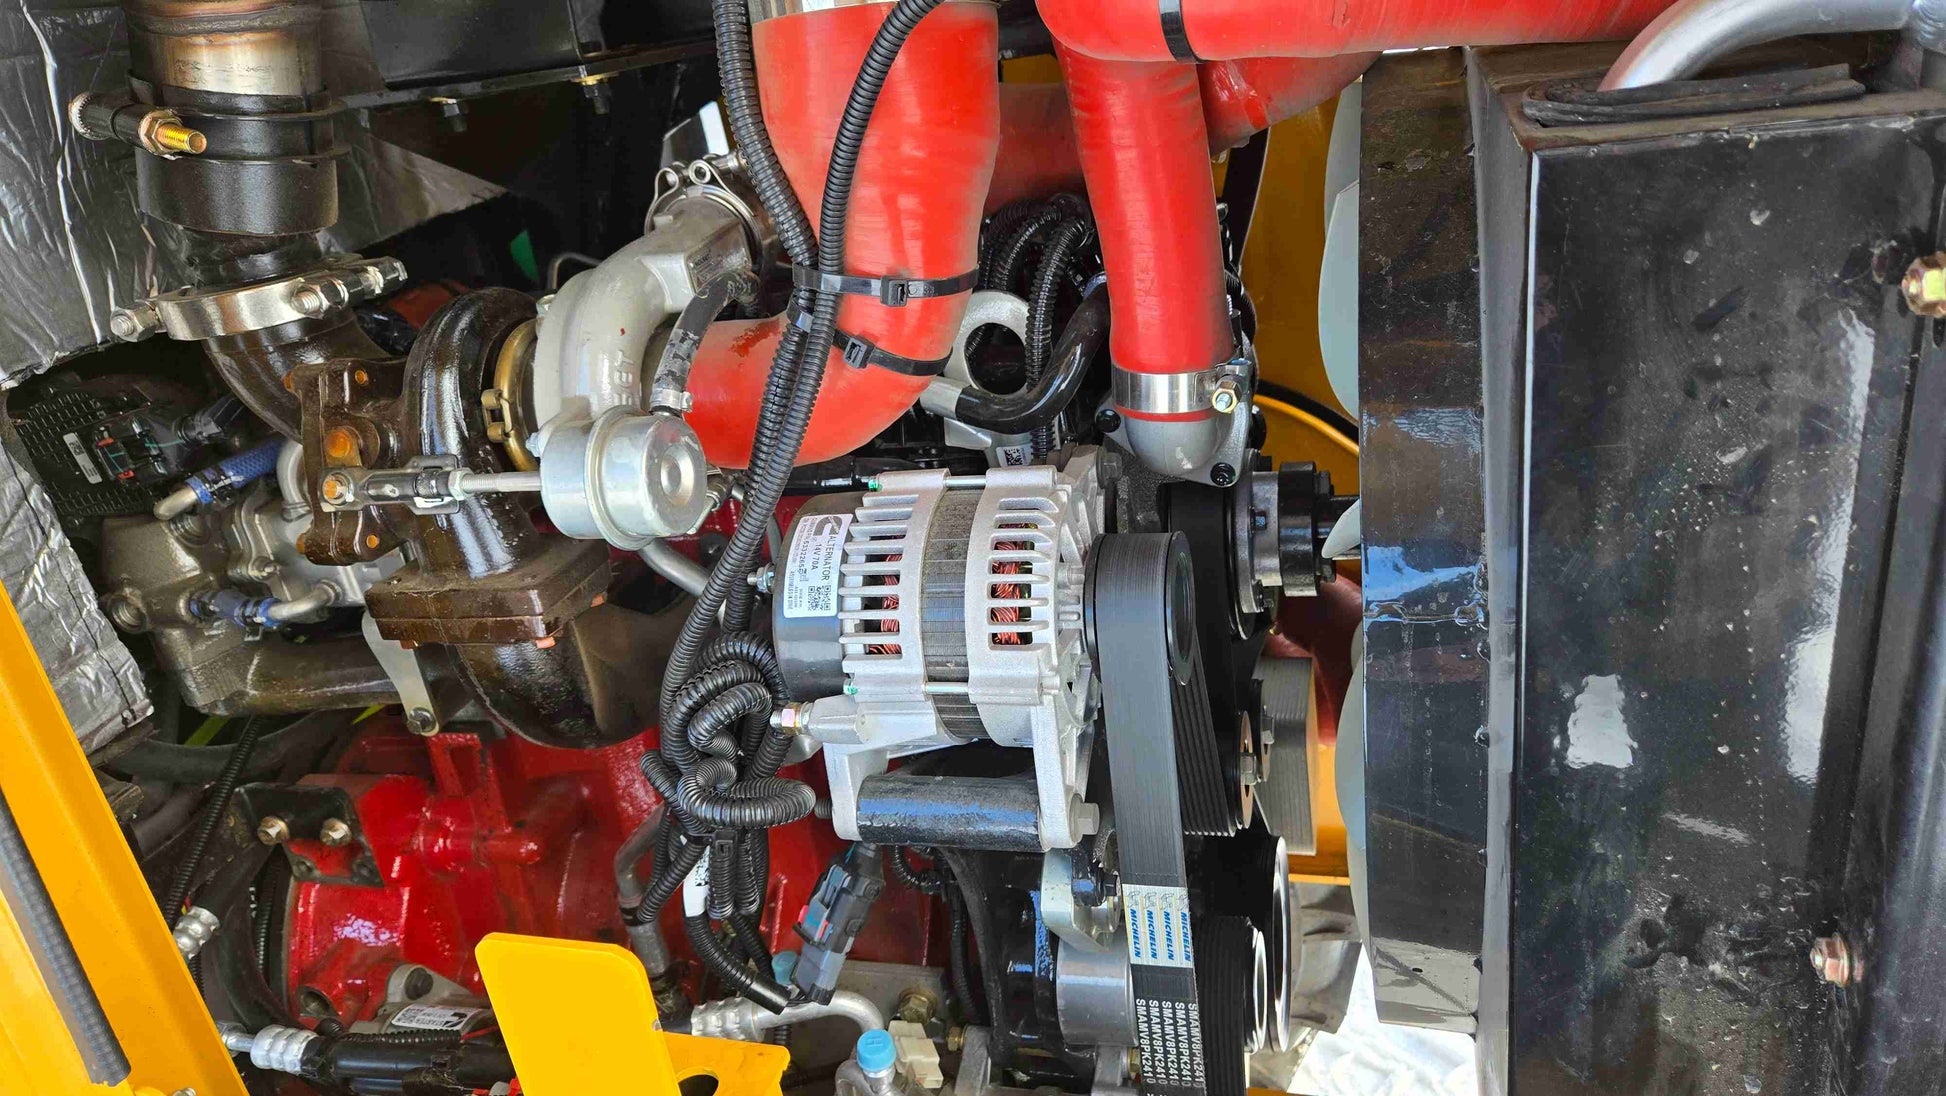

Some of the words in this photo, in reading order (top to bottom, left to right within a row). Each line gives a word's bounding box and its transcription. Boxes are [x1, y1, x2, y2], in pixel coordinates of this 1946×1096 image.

[810, 557, 820, 571] 70A
[813, 543, 822, 558] 14V
[821, 536, 836, 581] ALTERNATOR
[1131, 909, 1141, 958] MICHELIN
[1147, 910, 1157, 959] MICHELIN
[1164, 911, 1174, 960] MICHELIN
[1181, 912, 1191, 962] MICHELIN
[1136, 999, 1156, 1084] SMAMV8PK2410
[1148, 999, 1168, 1085] SMAMV8PK2410
[1162, 1000, 1180, 1086] SMAMV8PK2410
[1175, 1001, 1192, 1087] SMAMV8PK2410
